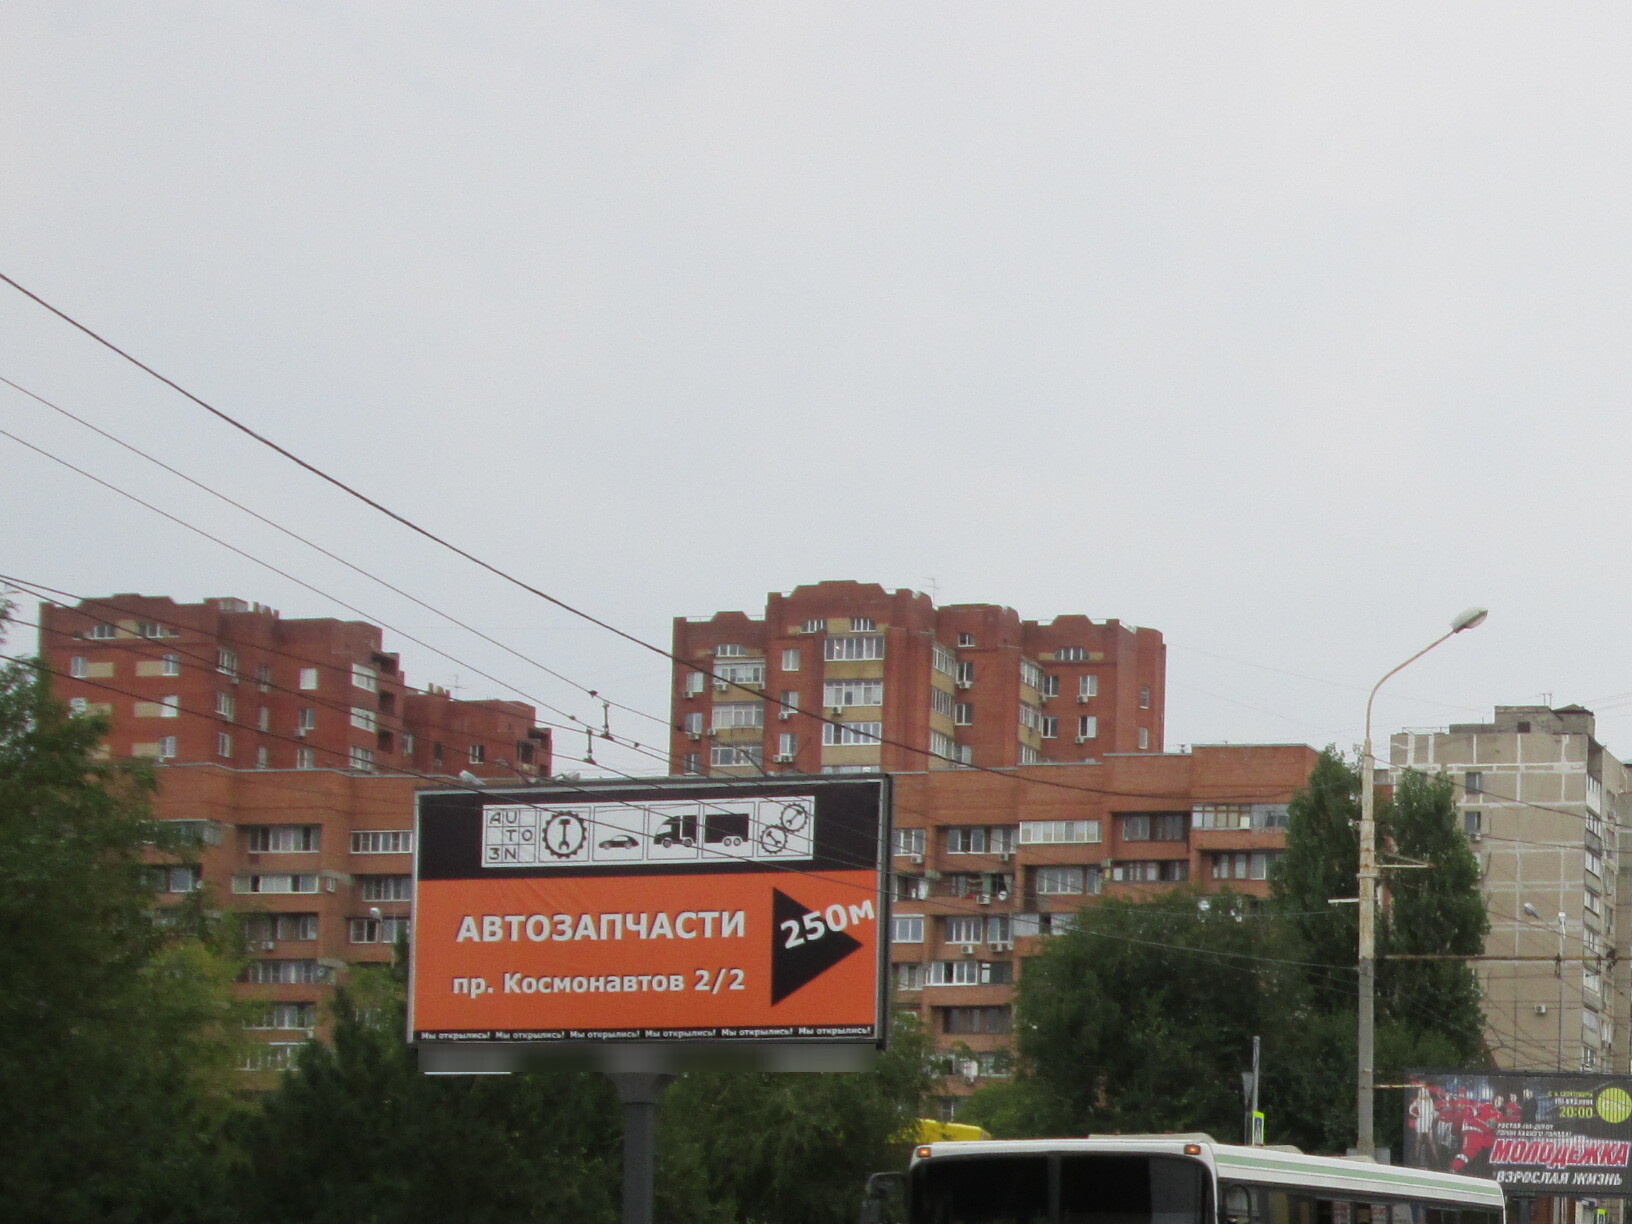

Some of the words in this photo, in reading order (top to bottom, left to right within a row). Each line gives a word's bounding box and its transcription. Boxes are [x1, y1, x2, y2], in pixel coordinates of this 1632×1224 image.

[456, 910, 745, 943] АВТОЗАПЧАСТИ
[452, 976, 494, 999] пр.
[503, 972, 685, 994] Космонавтов
[693, 968, 746, 995] 2/2
[438, 1031, 491, 1040] открылись!
[495, 1031, 510, 1039] Мы
[513, 1031, 565, 1040] открылись!
[569, 1030, 585, 1038] Мы
[587, 1030, 641, 1039] открылись!
[644, 1029, 660, 1037] Мы
[662, 1029, 716, 1038] открылись!
[721, 1028, 737, 1037] Мы
[738, 1028, 794, 1037] открылись!
[798, 1027, 814, 1035] Мы
[816, 1026, 871, 1036] открылись!
[1559, 1106, 1594, 1119] 20:00
[1496, 1170, 1570, 1185] ВЗРОСЛАЯ
[1572, 1172, 1623, 1186] ЖИЗНЬ
